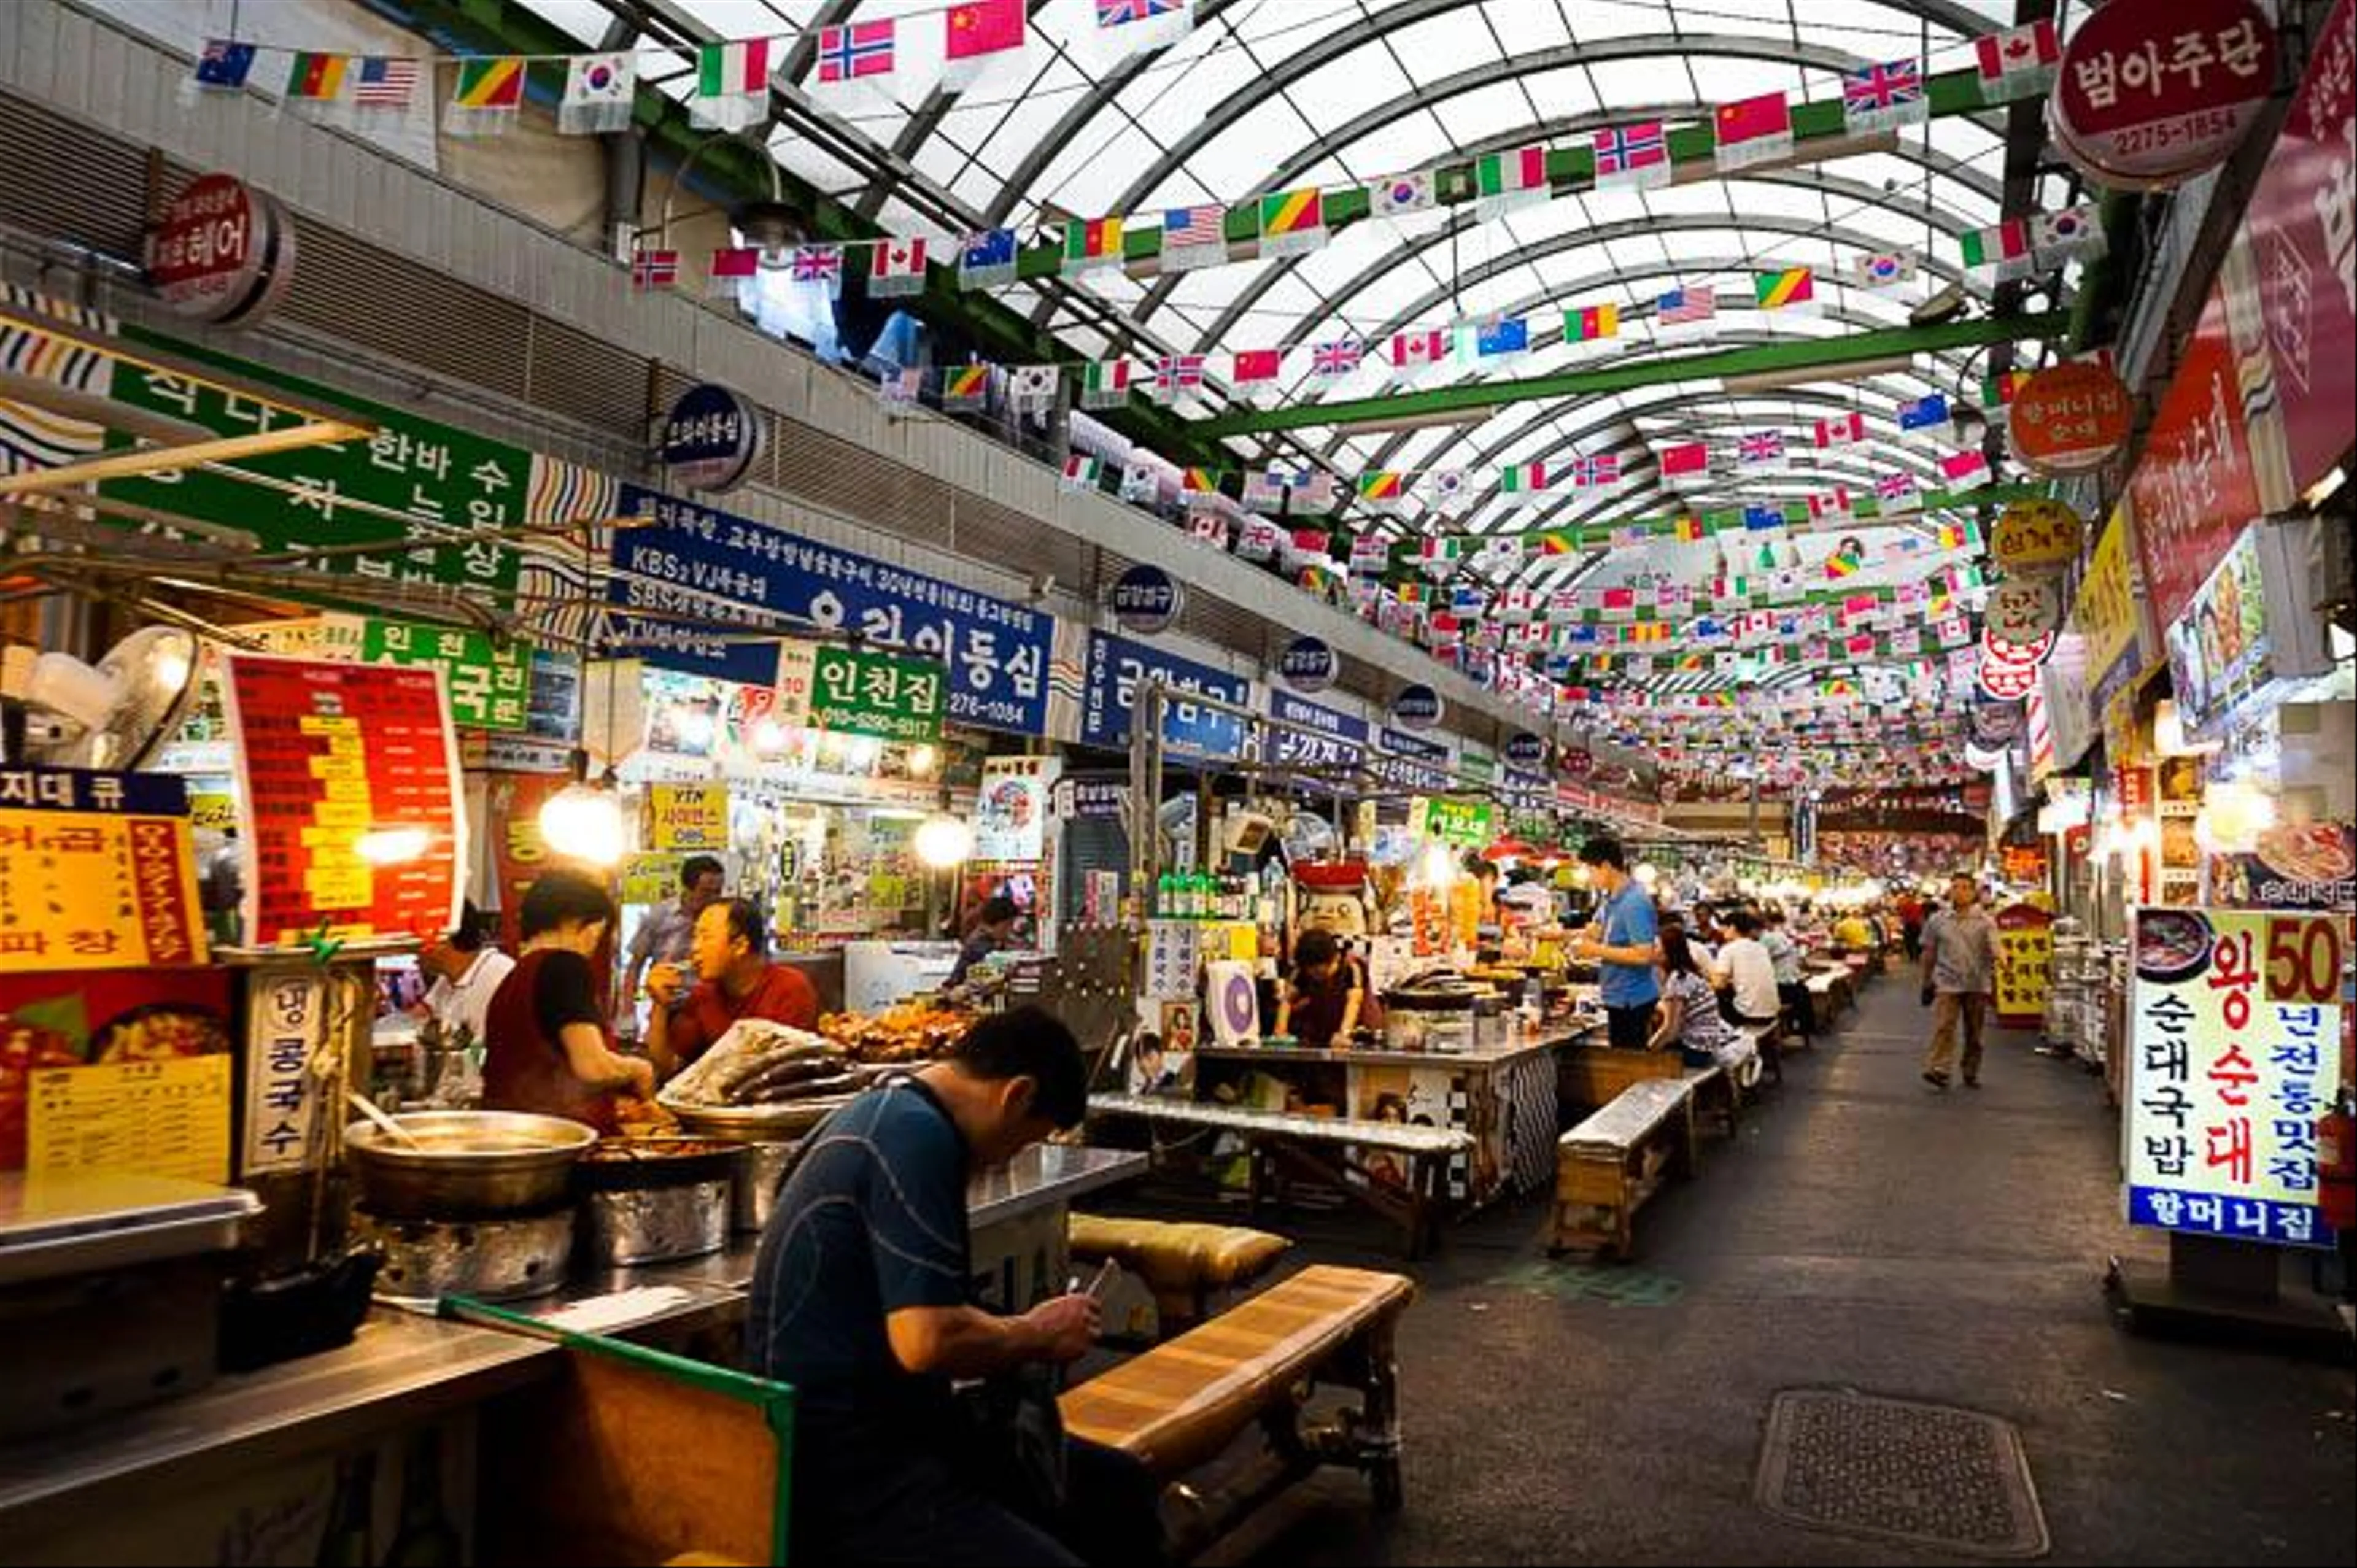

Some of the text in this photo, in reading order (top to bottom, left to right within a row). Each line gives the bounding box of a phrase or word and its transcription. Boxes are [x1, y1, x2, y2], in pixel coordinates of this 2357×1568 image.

[2075, 17, 2264, 110] 범아주단
[821, 658, 940, 714] 인천집
[2265, 919, 2340, 1002] 50
[261, 985, 307, 1154] 냉콩국수
[2141, 992, 2196, 1178] 순대국밥
[2207, 929, 2260, 1185] 왕순대
[2268, 1006, 2322, 1190] 년전통맛집
[2147, 1192, 2315, 1240] 할머니집
